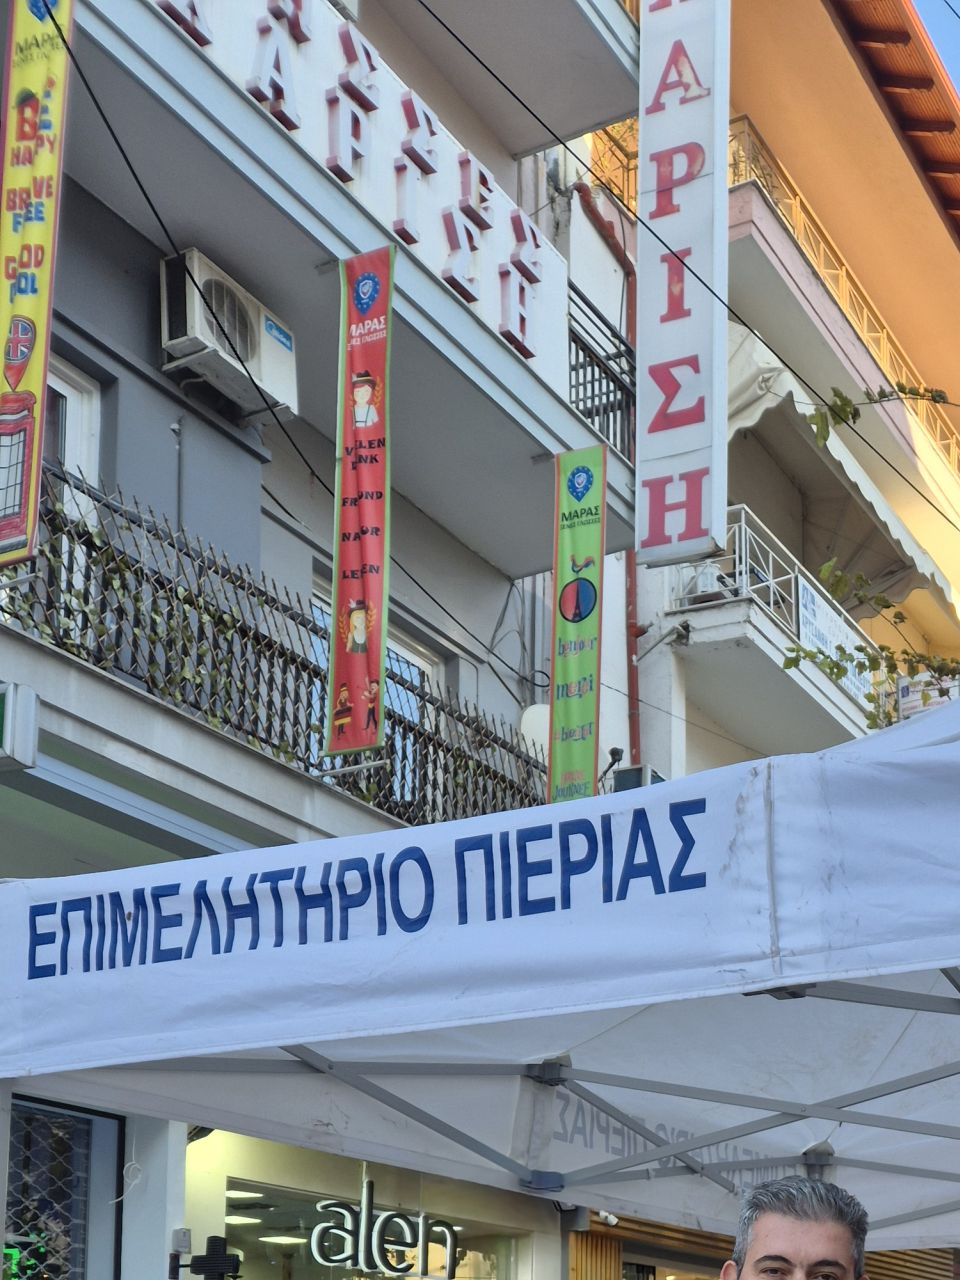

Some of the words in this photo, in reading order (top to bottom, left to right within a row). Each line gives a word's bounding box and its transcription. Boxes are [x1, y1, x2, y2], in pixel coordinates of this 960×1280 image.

[5, 174, 54, 212] BRVE
[12, 201, 45, 233] FEE
[4, 243, 45, 281] GOD
[641, 0, 711, 549] ΑΡΙΣΗ
[351, 454, 379, 471] DNK
[342, 490, 383, 507] FRUND
[561, 505, 600, 522] ΜΑΡΑΣ
[342, 563, 380, 580] LEEN
[27, 845, 435, 980] ΕΠΙΜΕΛΗΤΗΡΙΟ
[453, 797, 708, 926] ΠΙΕΡΙΑΣ
[311, 1179, 457, 1280] alen
